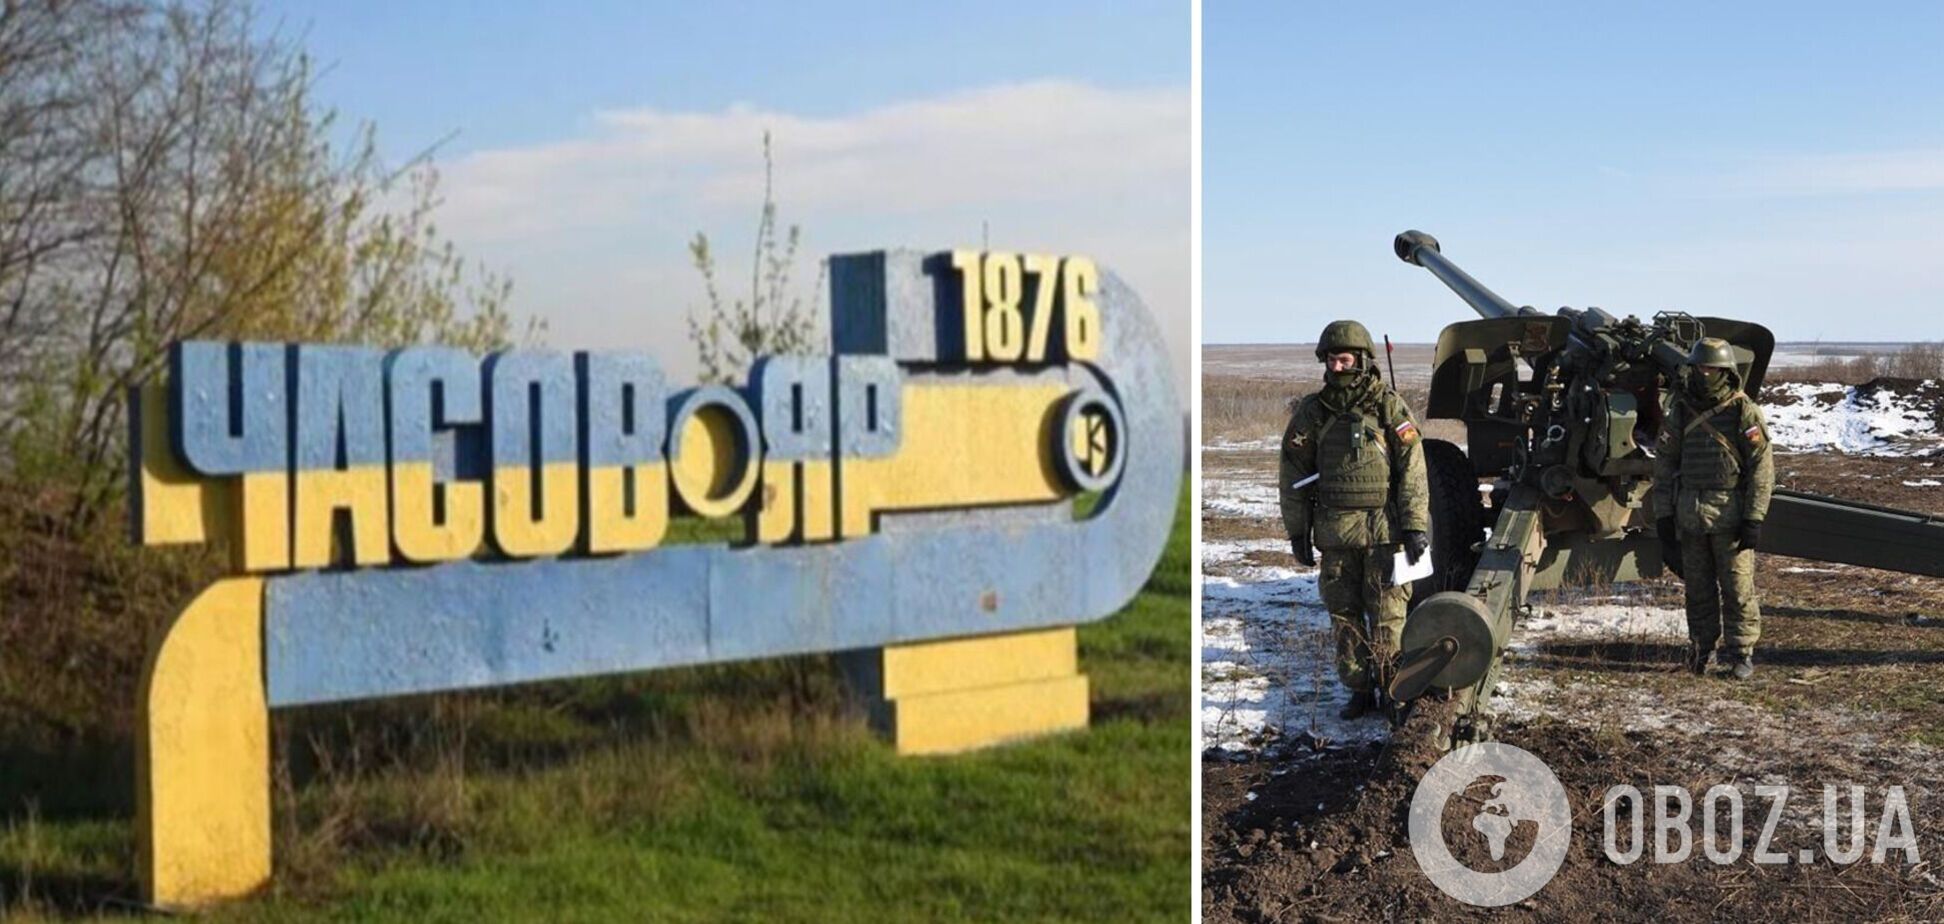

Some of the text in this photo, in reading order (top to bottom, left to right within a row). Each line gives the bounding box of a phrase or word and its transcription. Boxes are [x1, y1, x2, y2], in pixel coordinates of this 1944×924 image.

[952, 249, 1100, 362] 1876
[180, 339, 903, 571] ЧАСОВ ЯР
